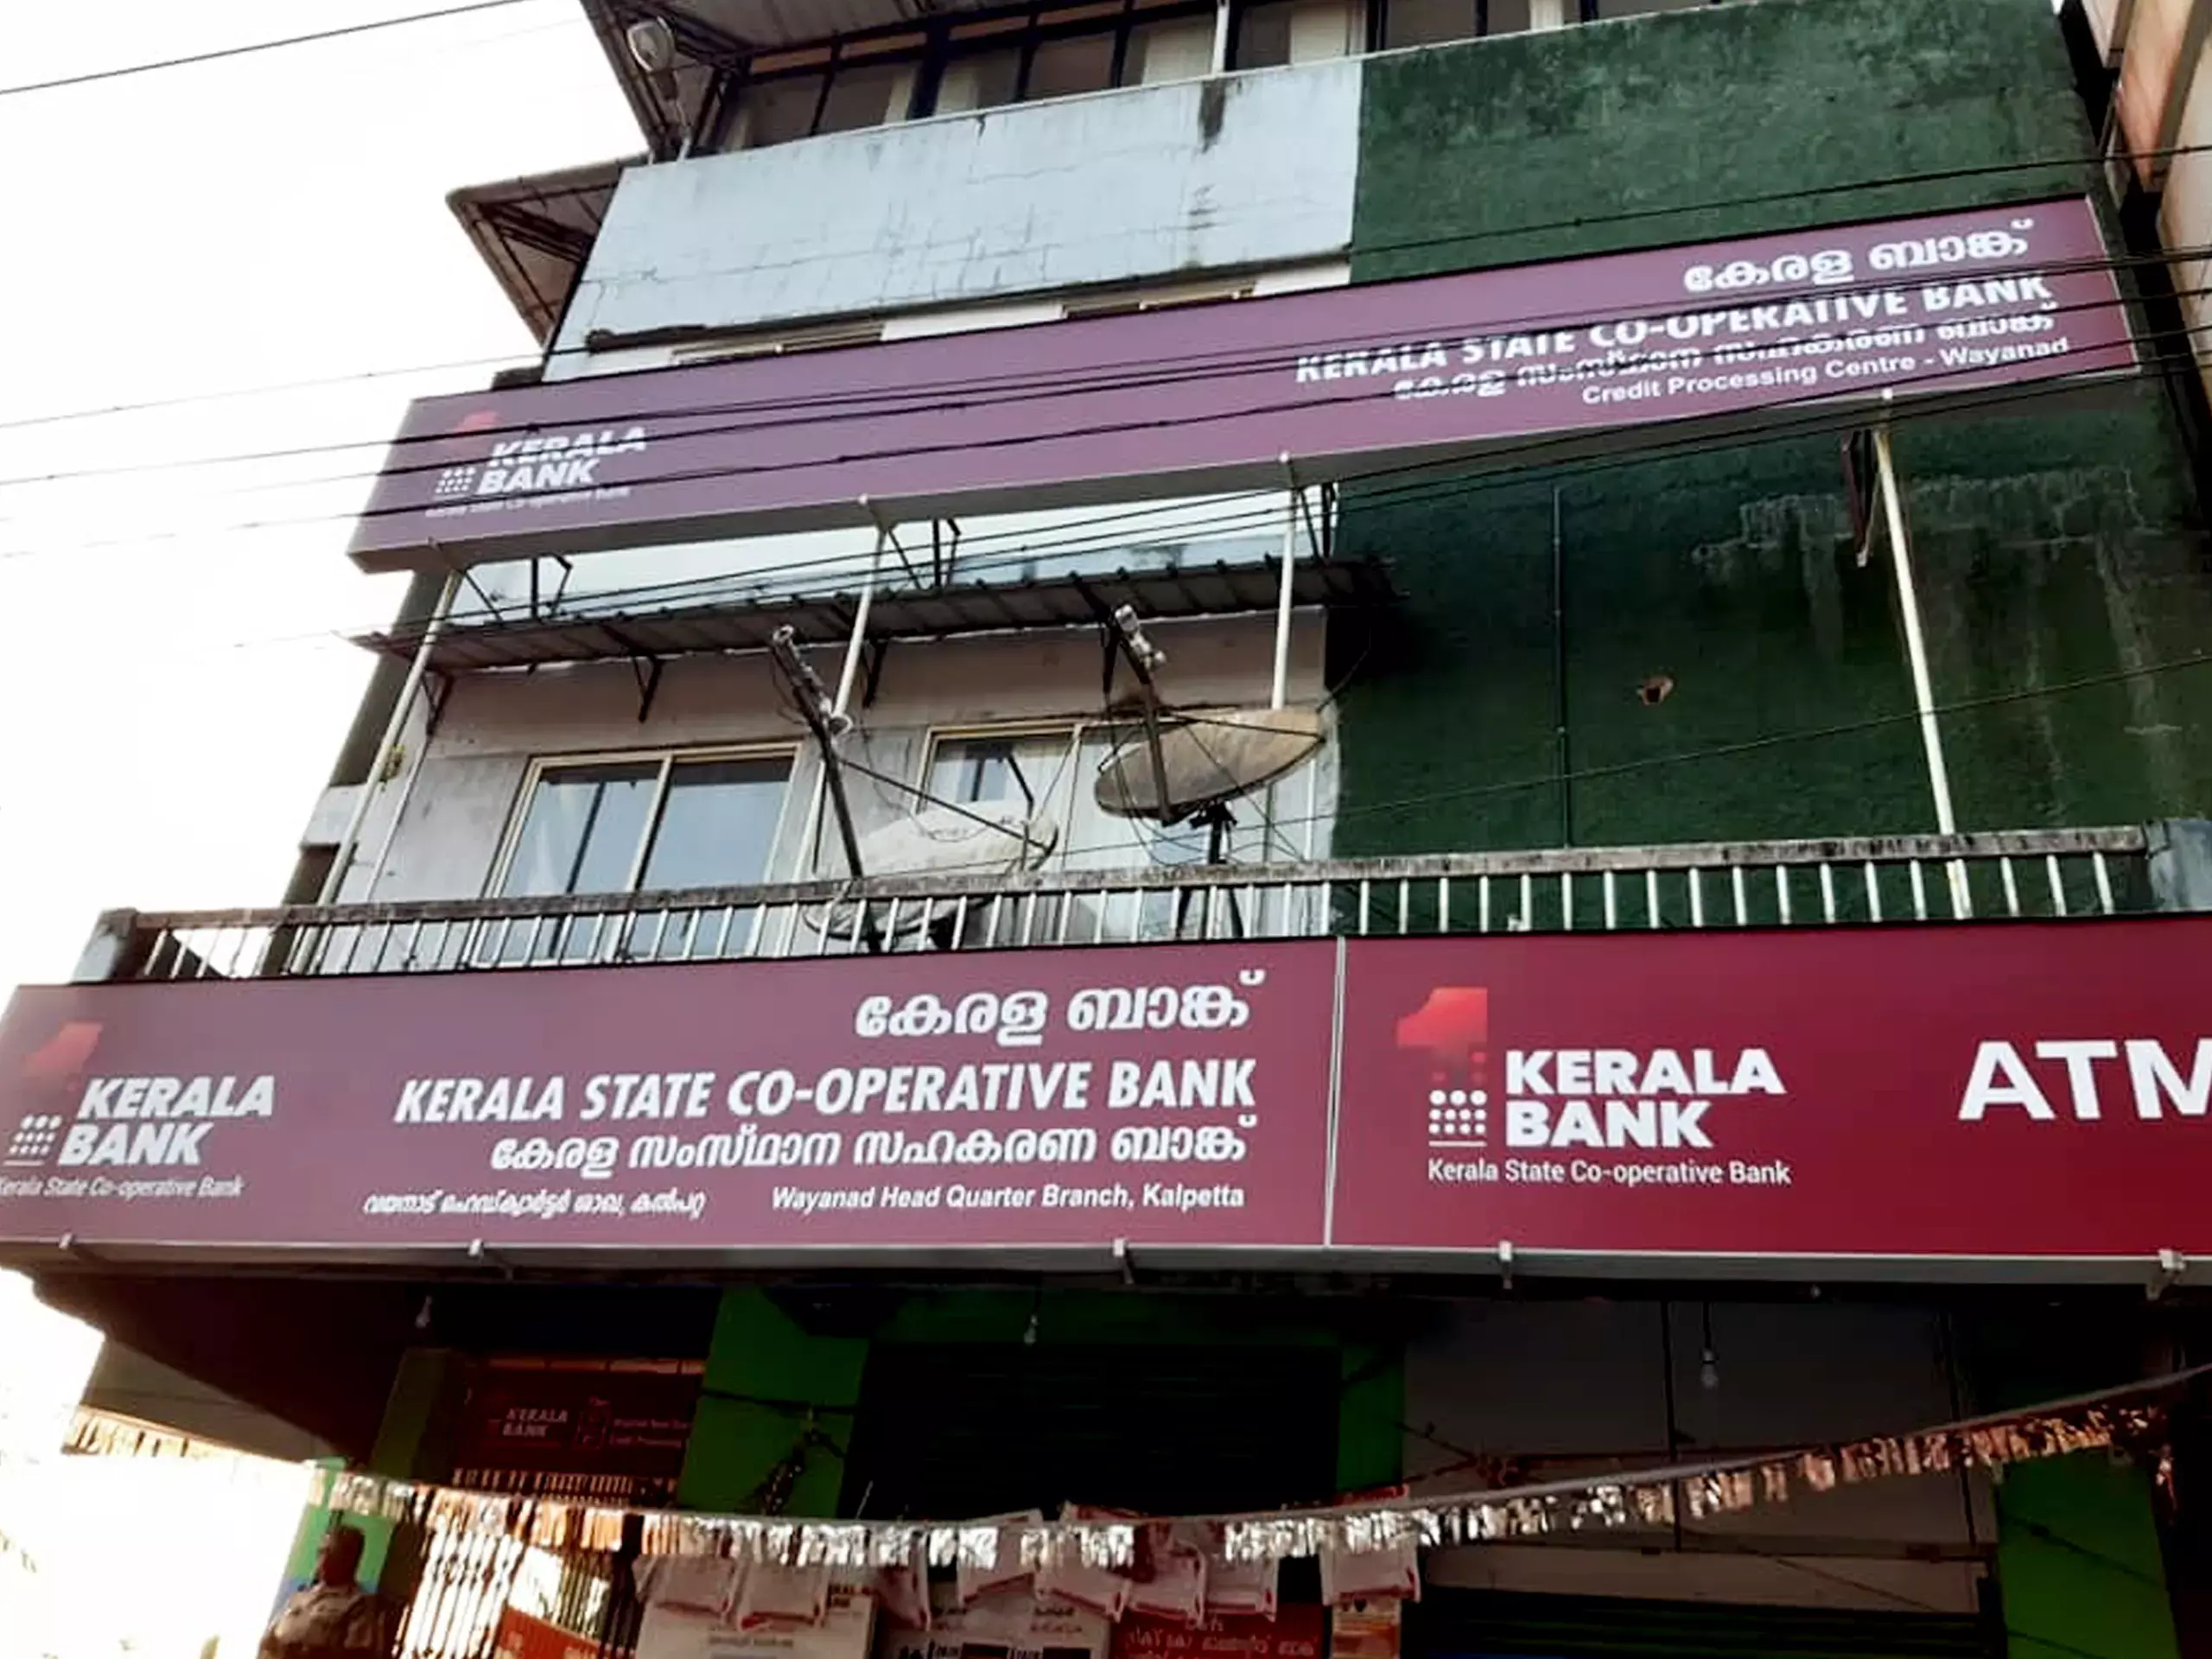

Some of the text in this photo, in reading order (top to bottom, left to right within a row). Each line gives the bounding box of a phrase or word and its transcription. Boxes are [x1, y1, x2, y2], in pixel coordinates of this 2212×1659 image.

[1683, 217, 2034, 292] കേരള ബാങ്ക്
[1295, 274, 2053, 383] KERALA STATE CO-OPERATIVE BANK
[1583, 381, 1660, 403] Credit
[1666, 364, 1818, 395] Processing
[1826, 358, 1915, 378] Centre
[1939, 335, 2069, 365] Wayanad
[488, 427, 646, 467] KERALA
[477, 458, 600, 495] BANK
[856, 969, 1266, 1046] കേരള ബാങ്ക്
[395, 1061, 1255, 1122] KERALA STATE CO-OPERATIVE BANK
[1506, 1047, 1786, 1095] KERALA
[1959, 1039, 2212, 1119] ATM
[79, 1075, 275, 1119] KERALA
[57, 1122, 214, 1166] BANK
[493, 1138, 619, 1178] കേരള
[855, 1129, 1096, 1163] സഹകരണ
[1111, 1114, 1258, 1160] ബാങ്ക്
[1507, 1101, 1713, 1147] BANK
[198, 1175, 245, 1197] Bank
[1429, 1159, 1790, 1187] Kerala State Co-operative Bank
[774, 1184, 1243, 1213] Wayanad Head Quarter Branch, Kalpetta
